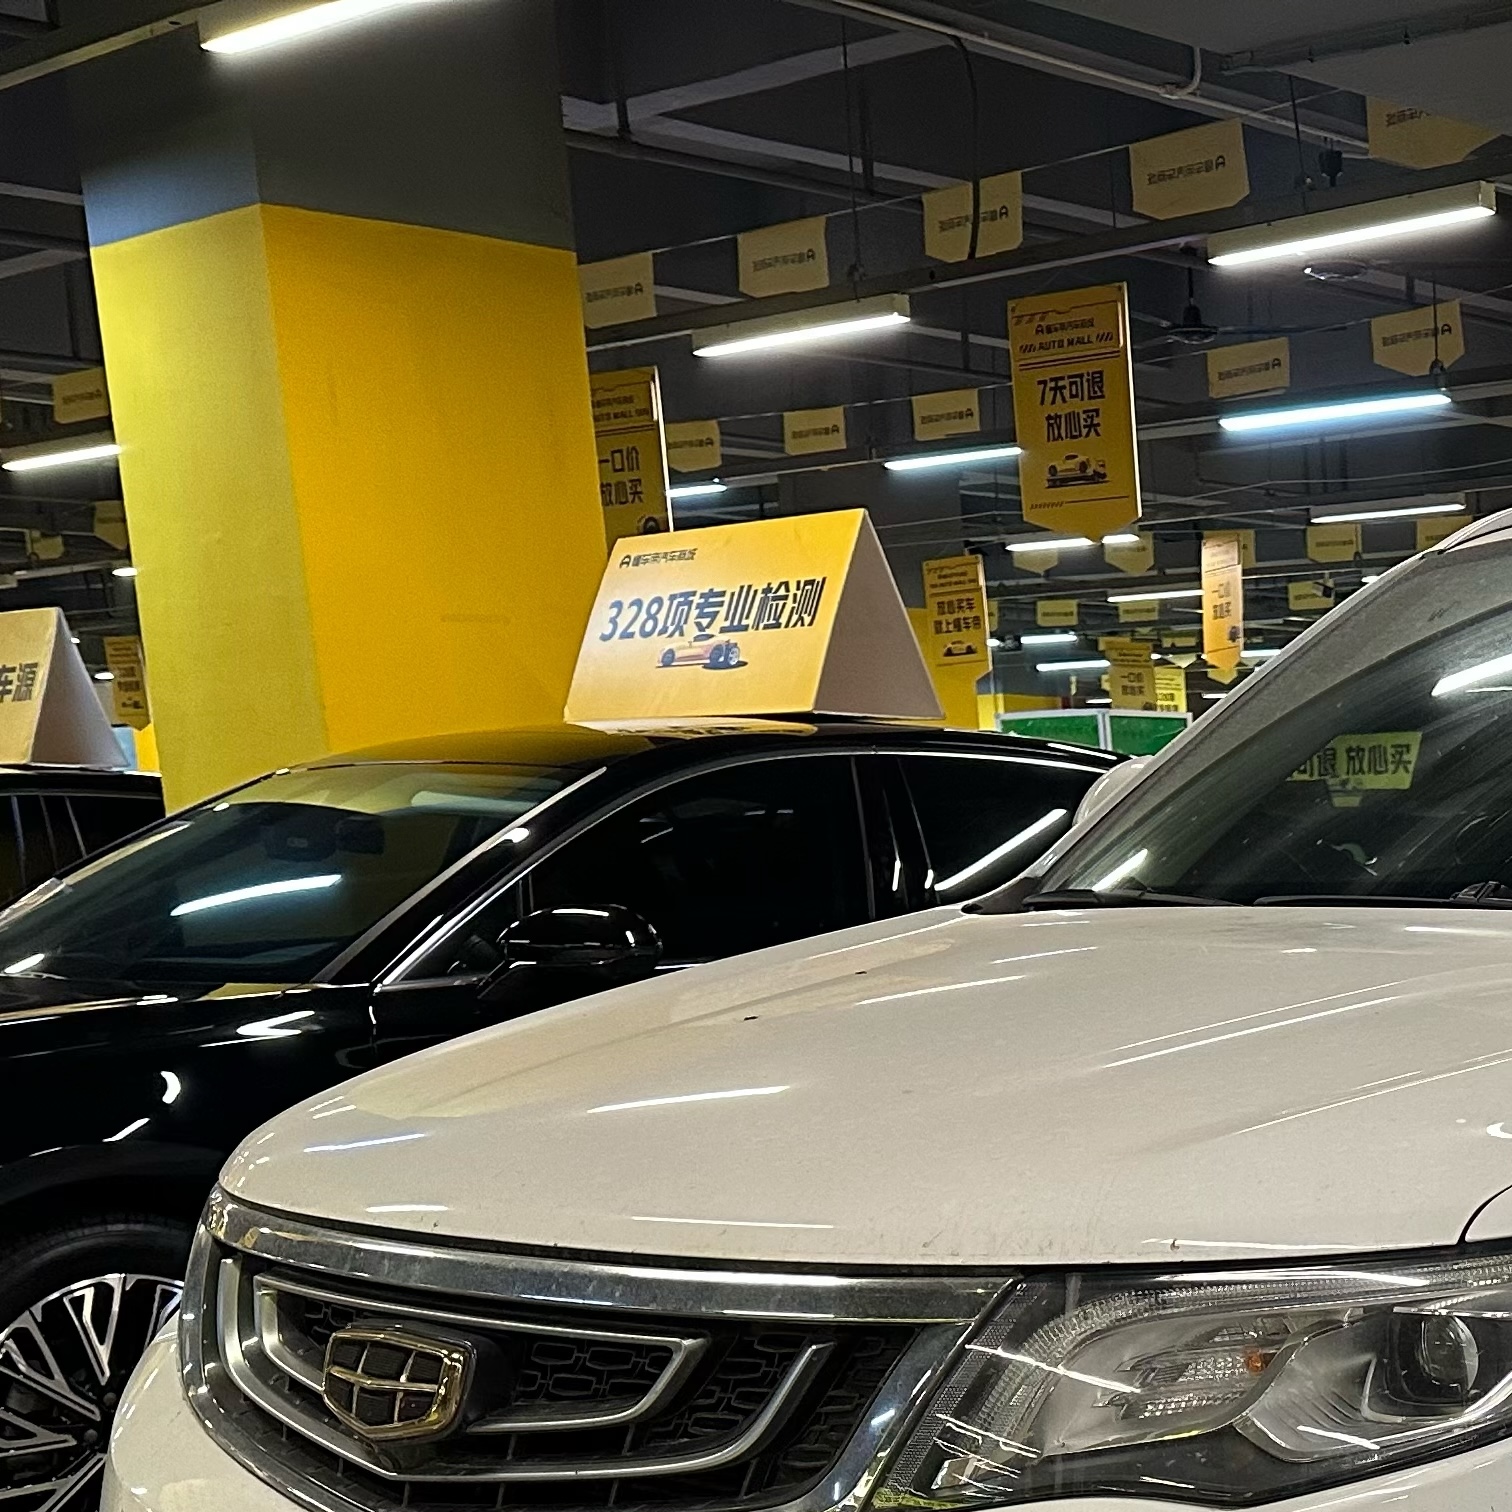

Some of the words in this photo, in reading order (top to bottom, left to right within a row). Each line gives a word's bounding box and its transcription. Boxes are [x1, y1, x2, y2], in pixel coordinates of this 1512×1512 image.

[1038, 339, 1064, 351] AUTO
[1066, 334, 1094, 347] MALL
[1036, 370, 1105, 406] 7天可退
[1045, 408, 1101, 443] 放心买
[599, 445, 640, 473] 一口价
[599, 576, 827, 643] 328项专业检测
[1345, 744, 1412, 775] 放心买
